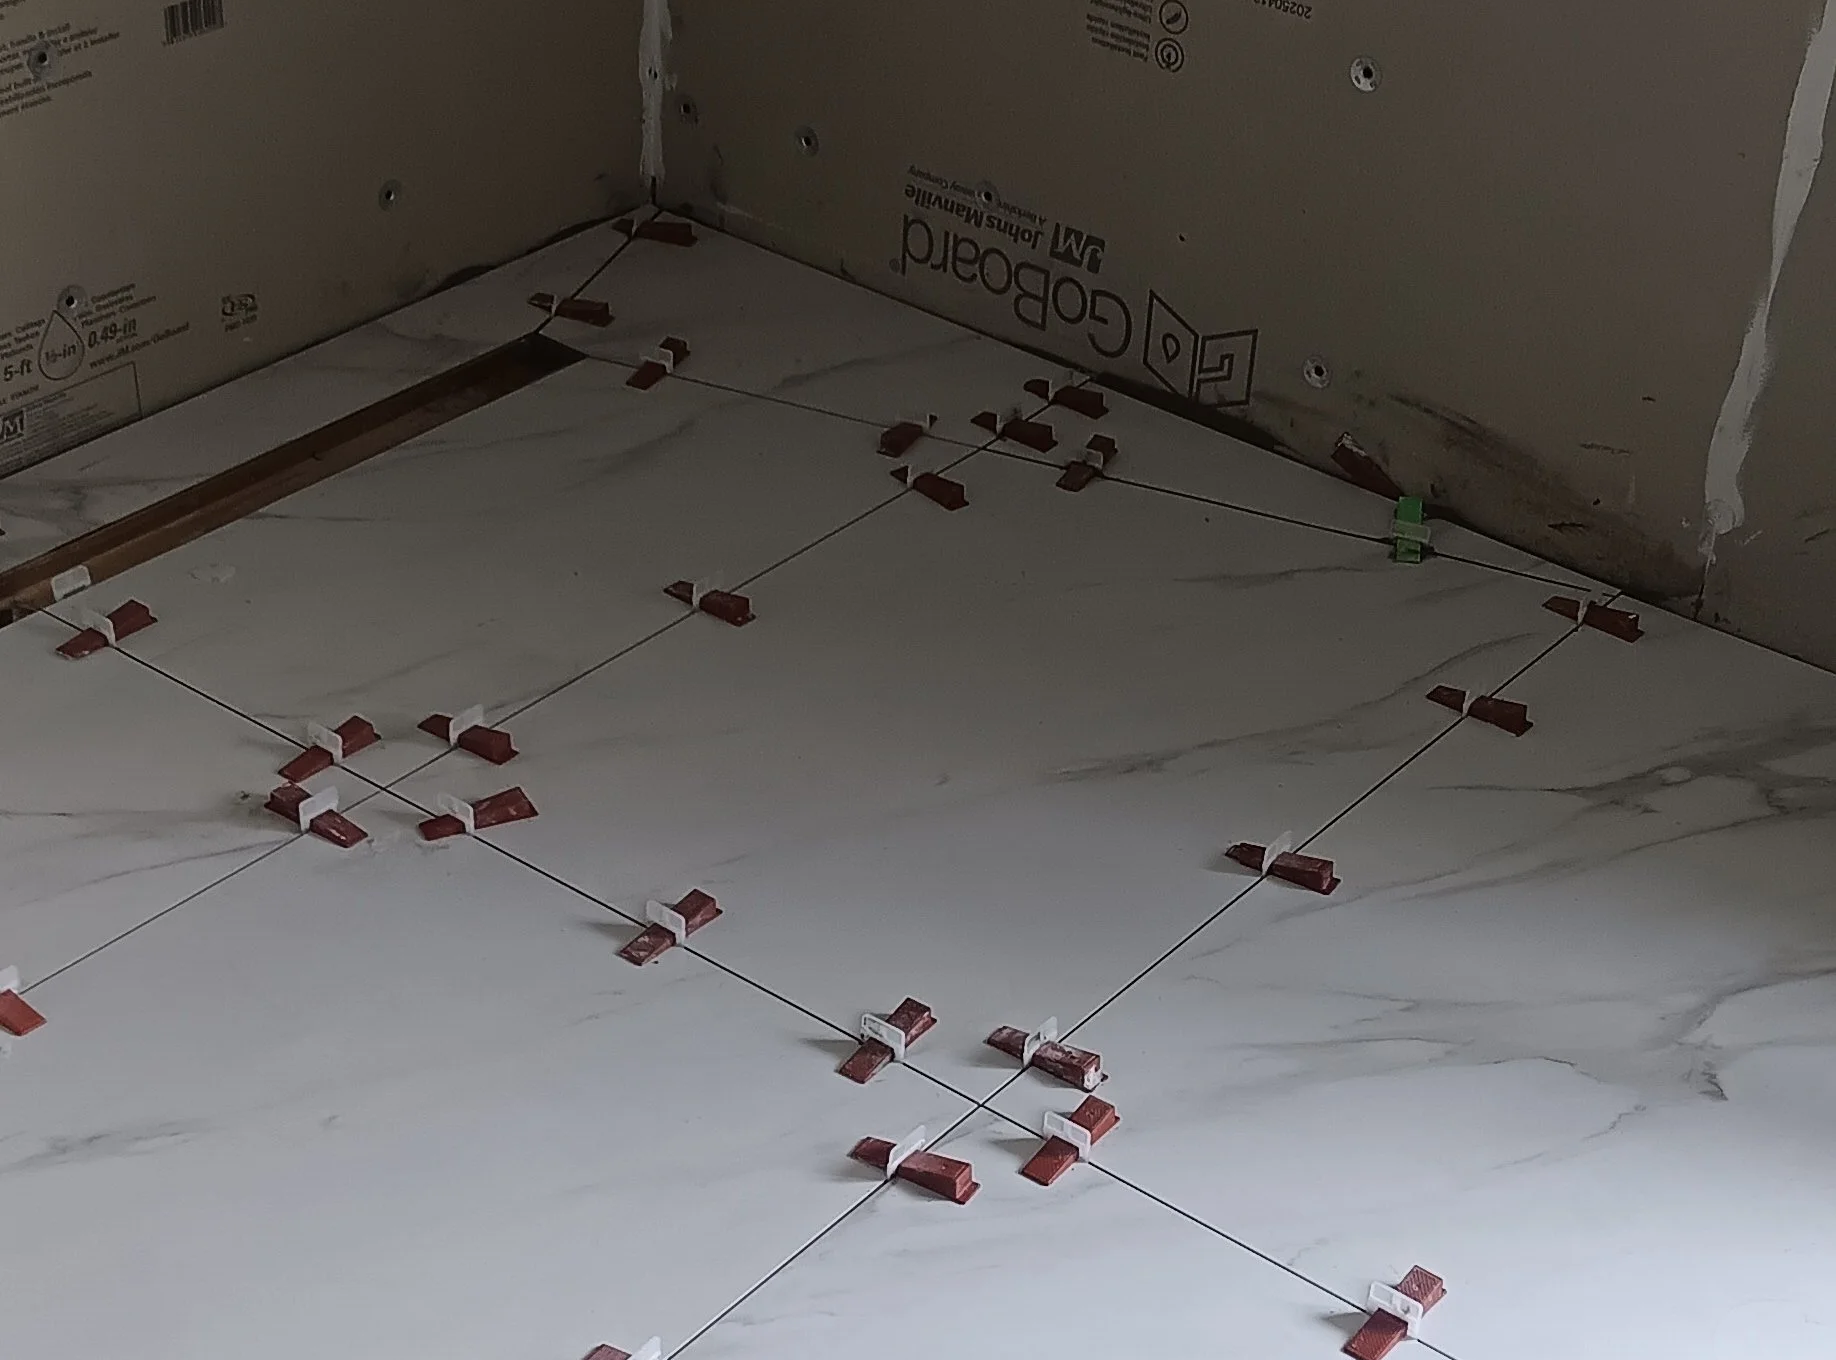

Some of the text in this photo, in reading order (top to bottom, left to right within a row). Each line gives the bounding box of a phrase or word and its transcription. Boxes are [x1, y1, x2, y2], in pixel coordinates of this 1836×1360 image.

[904, 184, 1044, 251] Johns Manville
[1048, 222, 1105, 274] JM
[88, 318, 137, 349] 0.49-in
[3, 358, 33, 383] 5-ft
